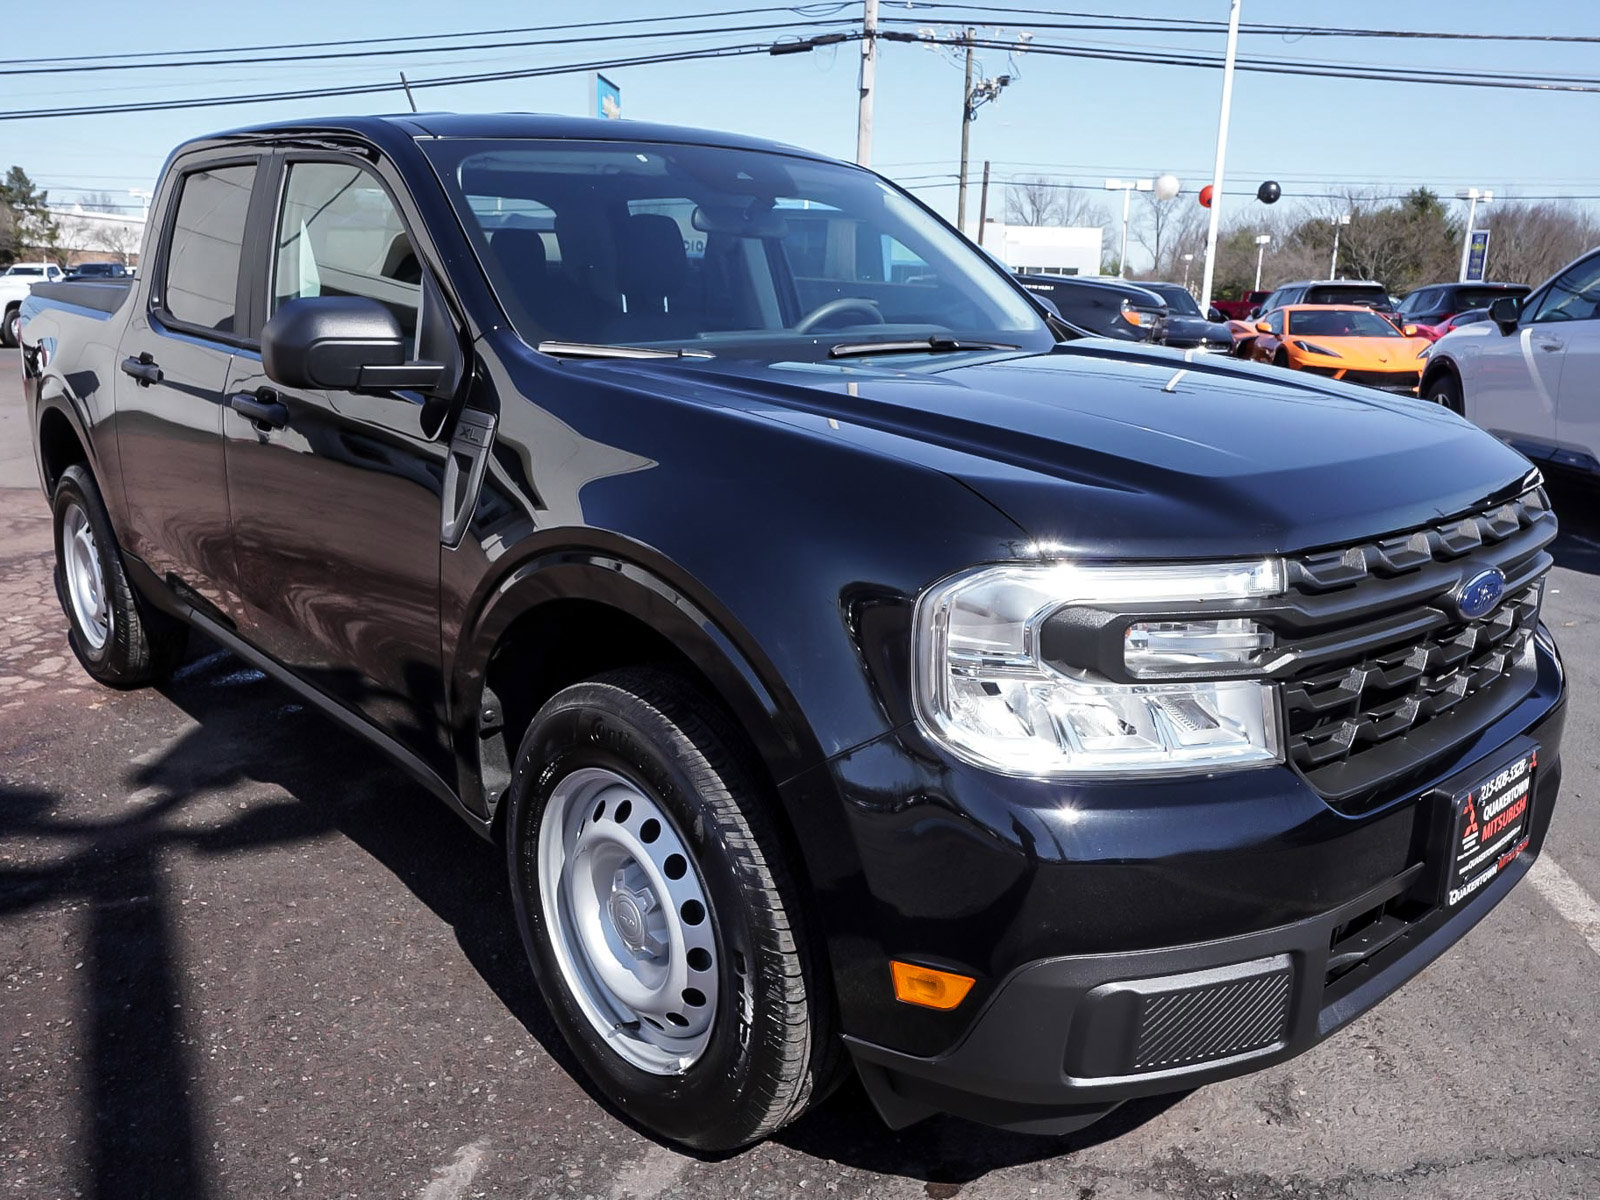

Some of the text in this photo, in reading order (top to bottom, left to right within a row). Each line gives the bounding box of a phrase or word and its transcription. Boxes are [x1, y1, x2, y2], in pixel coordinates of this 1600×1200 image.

[460, 425, 480, 442] XL
[1481, 792, 1528, 842] MITSUBISHI
[1483, 776, 1530, 821] QUAKERTOWN
